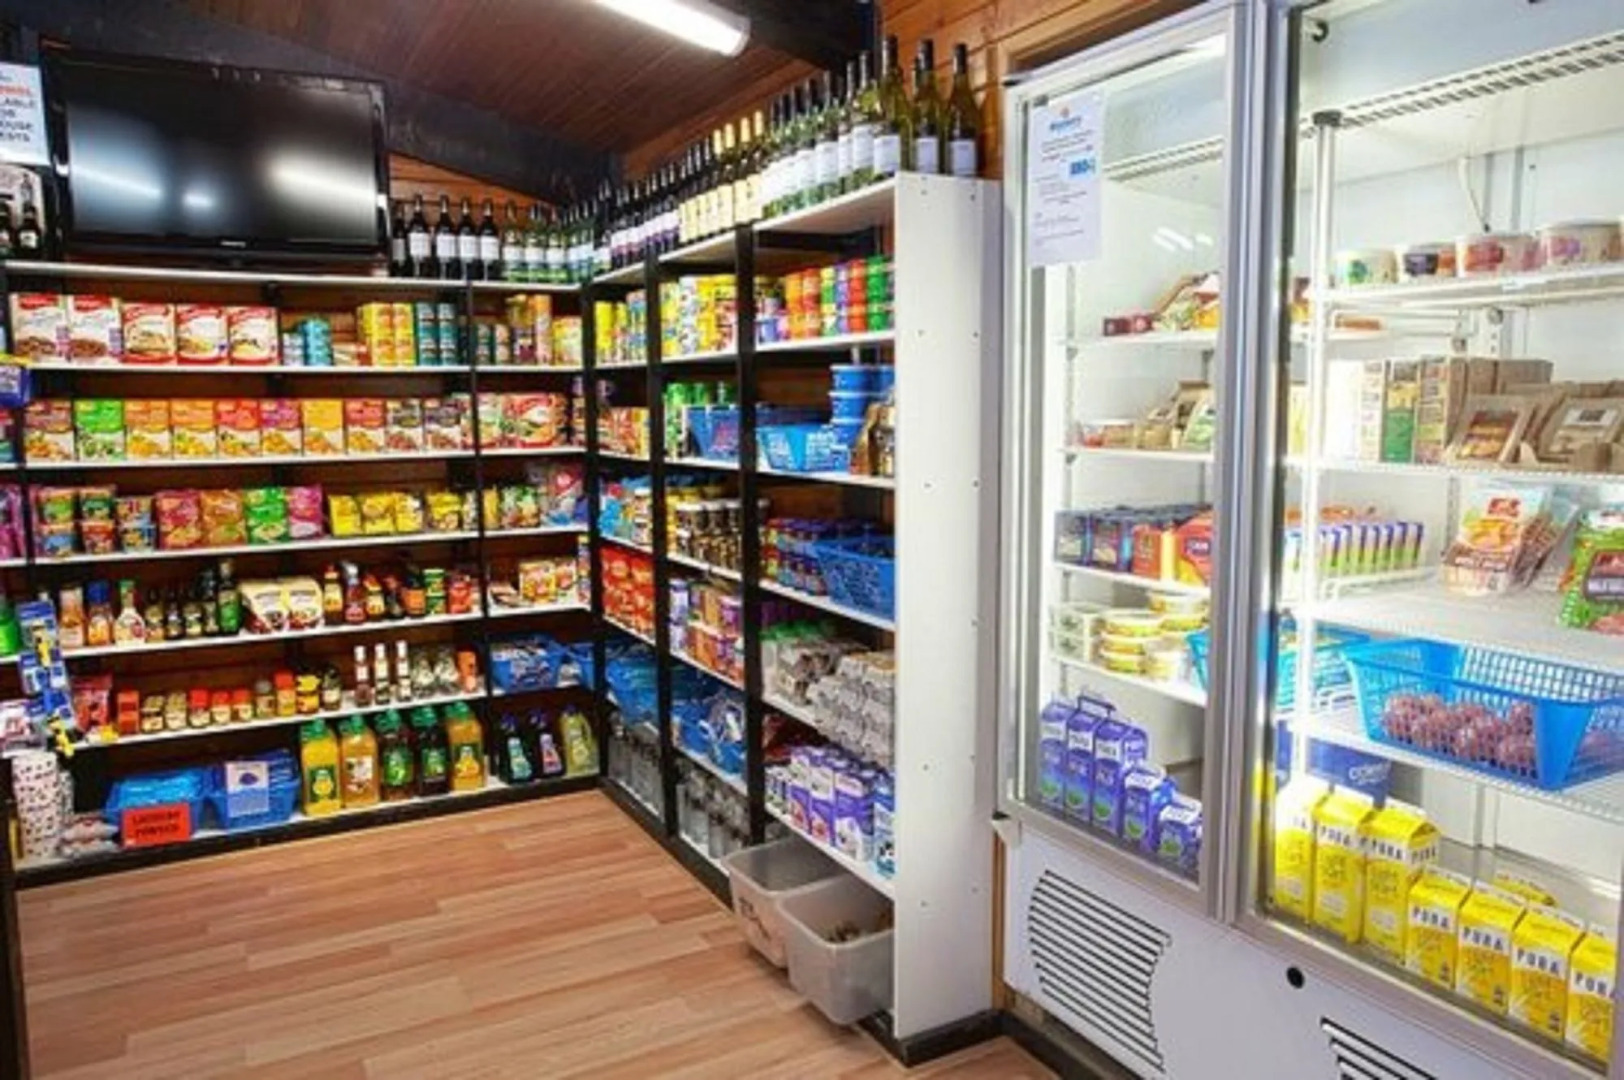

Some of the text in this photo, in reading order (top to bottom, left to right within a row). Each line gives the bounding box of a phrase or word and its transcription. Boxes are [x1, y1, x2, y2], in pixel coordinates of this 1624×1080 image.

[1412, 906, 1450, 928] PURA
[1463, 926, 1503, 951] PURA
[1516, 948, 1560, 975] PURA
